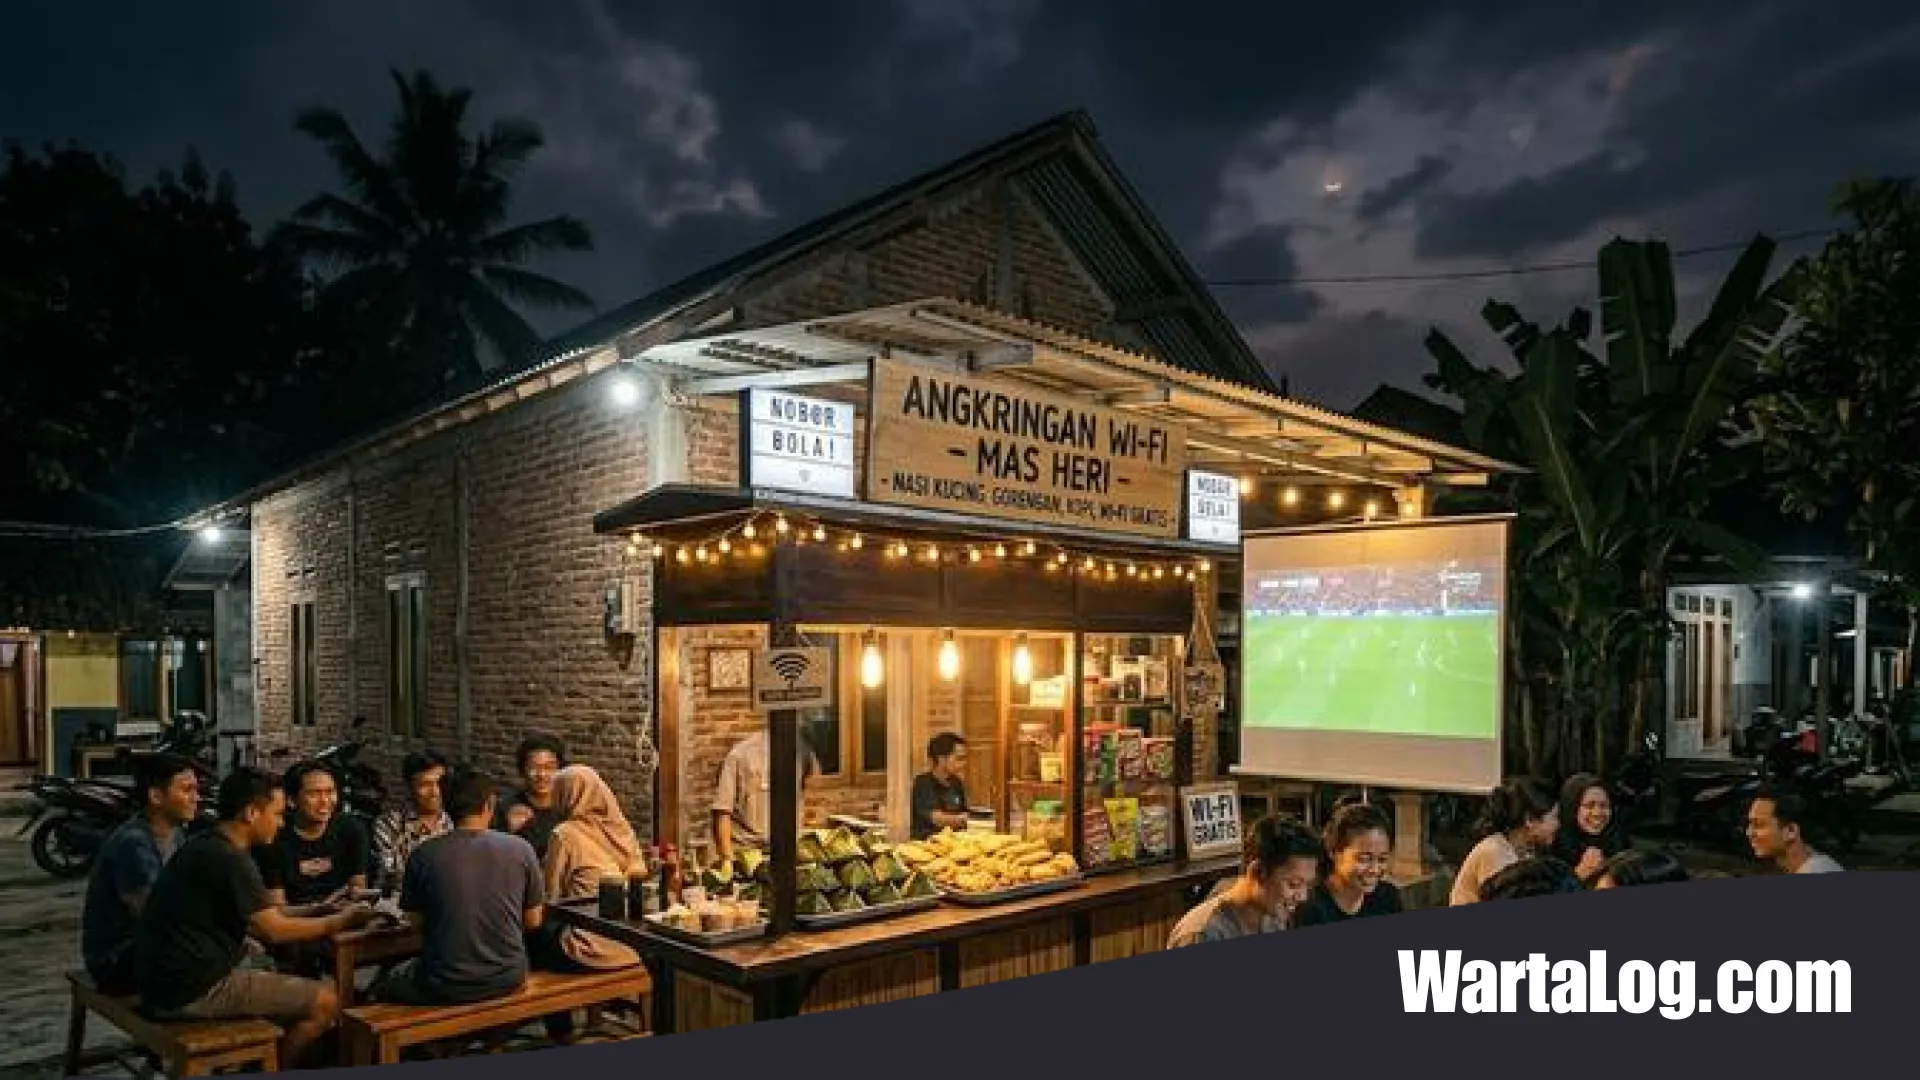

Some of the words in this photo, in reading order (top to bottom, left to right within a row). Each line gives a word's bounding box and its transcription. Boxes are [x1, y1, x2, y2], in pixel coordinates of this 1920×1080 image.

[901, 375, 1097, 450] ANGKRINGAN
[1109, 416, 1168, 465] WI-FI
[772, 430, 834, 459] BOLA!
[977, 436, 1039, 483] MAS
[1052, 452, 1111, 496] HERI
[1190, 795, 1233, 821] WI-FI
